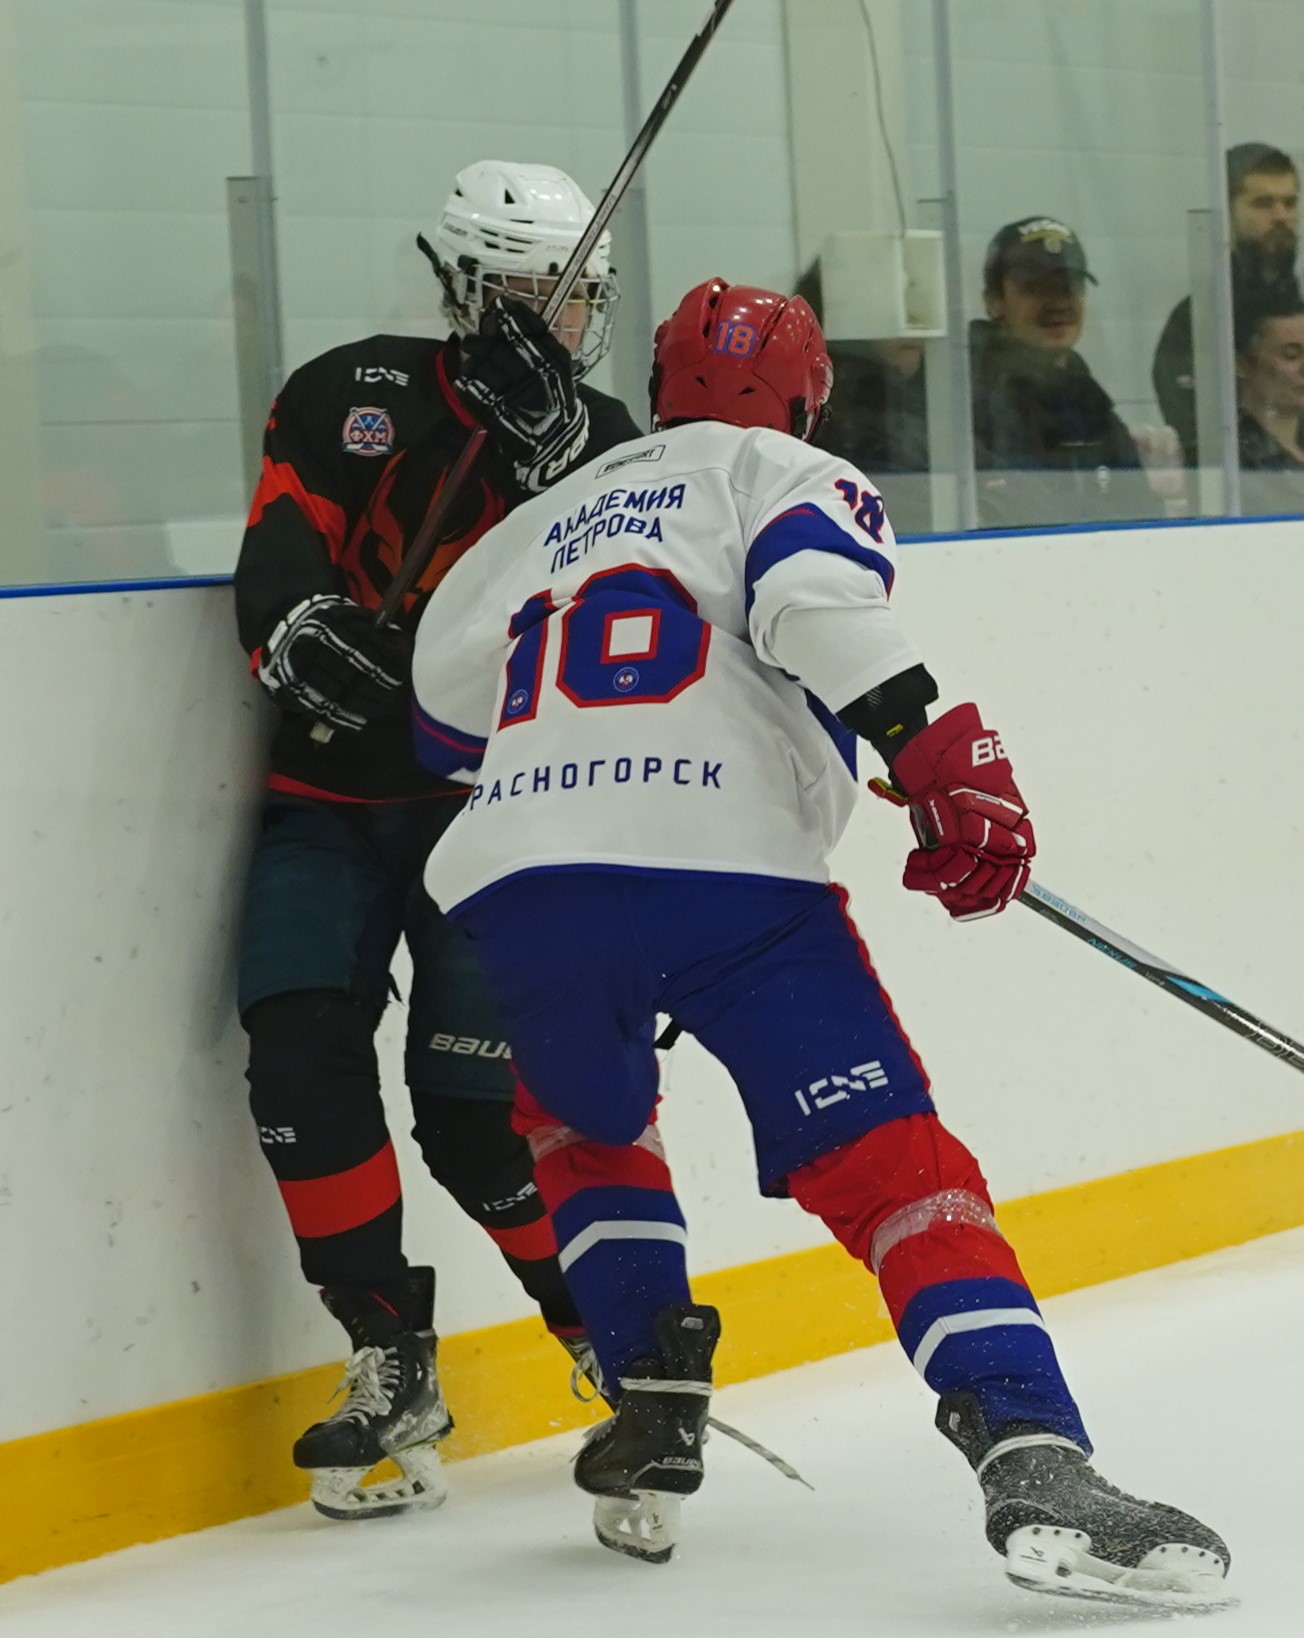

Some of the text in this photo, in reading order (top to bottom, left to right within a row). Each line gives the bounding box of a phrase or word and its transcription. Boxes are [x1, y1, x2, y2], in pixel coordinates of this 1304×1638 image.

[714, 320, 757, 358] 18
[350, 430, 388, 443] ФХМ
[543, 483, 686, 547] АКАДЕМИЯ
[551, 513, 663, 574] ПЕТРОВА
[469, 757, 723, 811] РАСНОГОРСК
